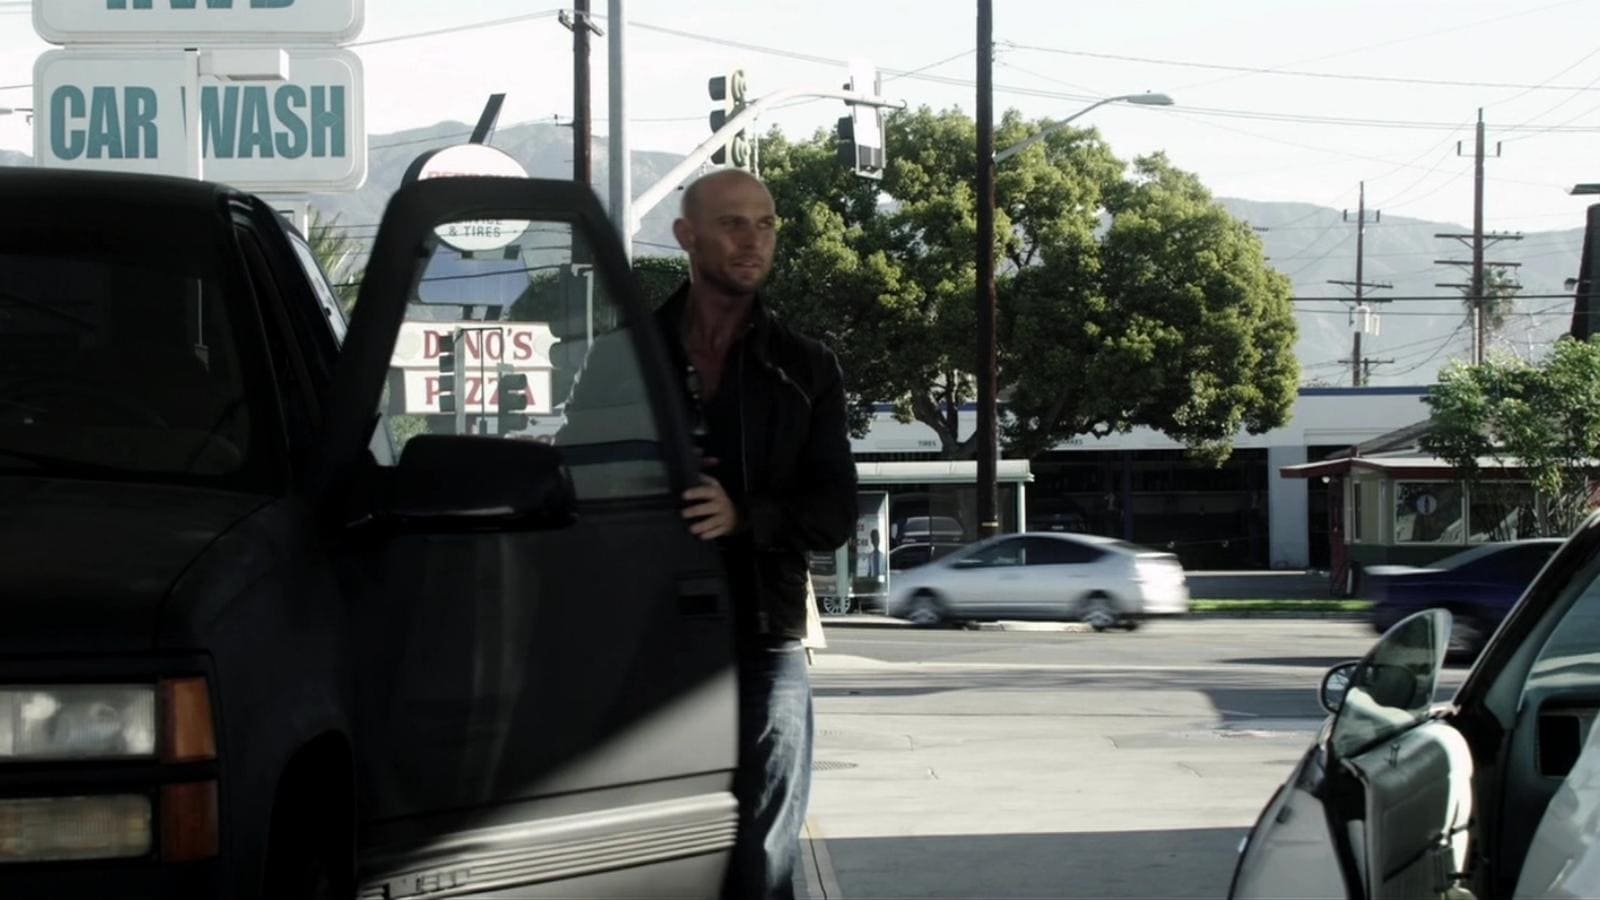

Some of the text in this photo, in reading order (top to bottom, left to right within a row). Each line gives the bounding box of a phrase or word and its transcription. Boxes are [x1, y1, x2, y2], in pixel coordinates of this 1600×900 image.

[50, 84, 346, 160] CAR WASH
[463, 225, 501, 238] TIRES
[423, 327, 533, 360] DNO'S
